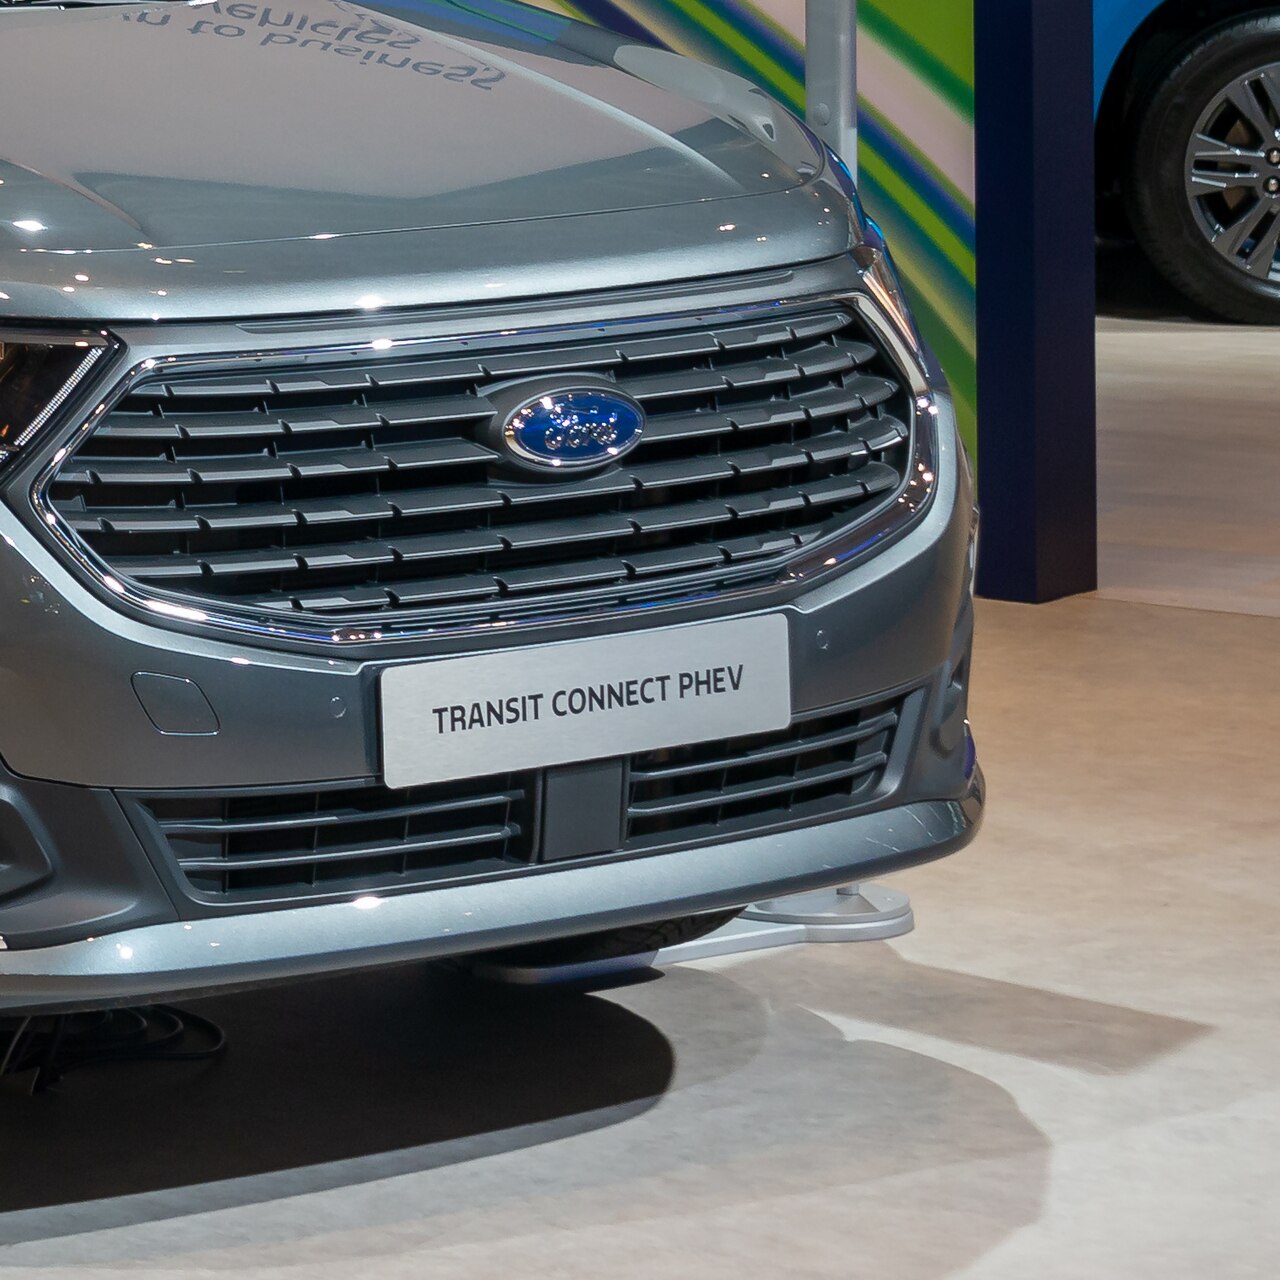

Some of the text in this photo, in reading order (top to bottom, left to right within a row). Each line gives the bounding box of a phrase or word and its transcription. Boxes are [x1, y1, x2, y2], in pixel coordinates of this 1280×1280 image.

[431, 663, 745, 735] TRANSIT CONNECT PHEV
